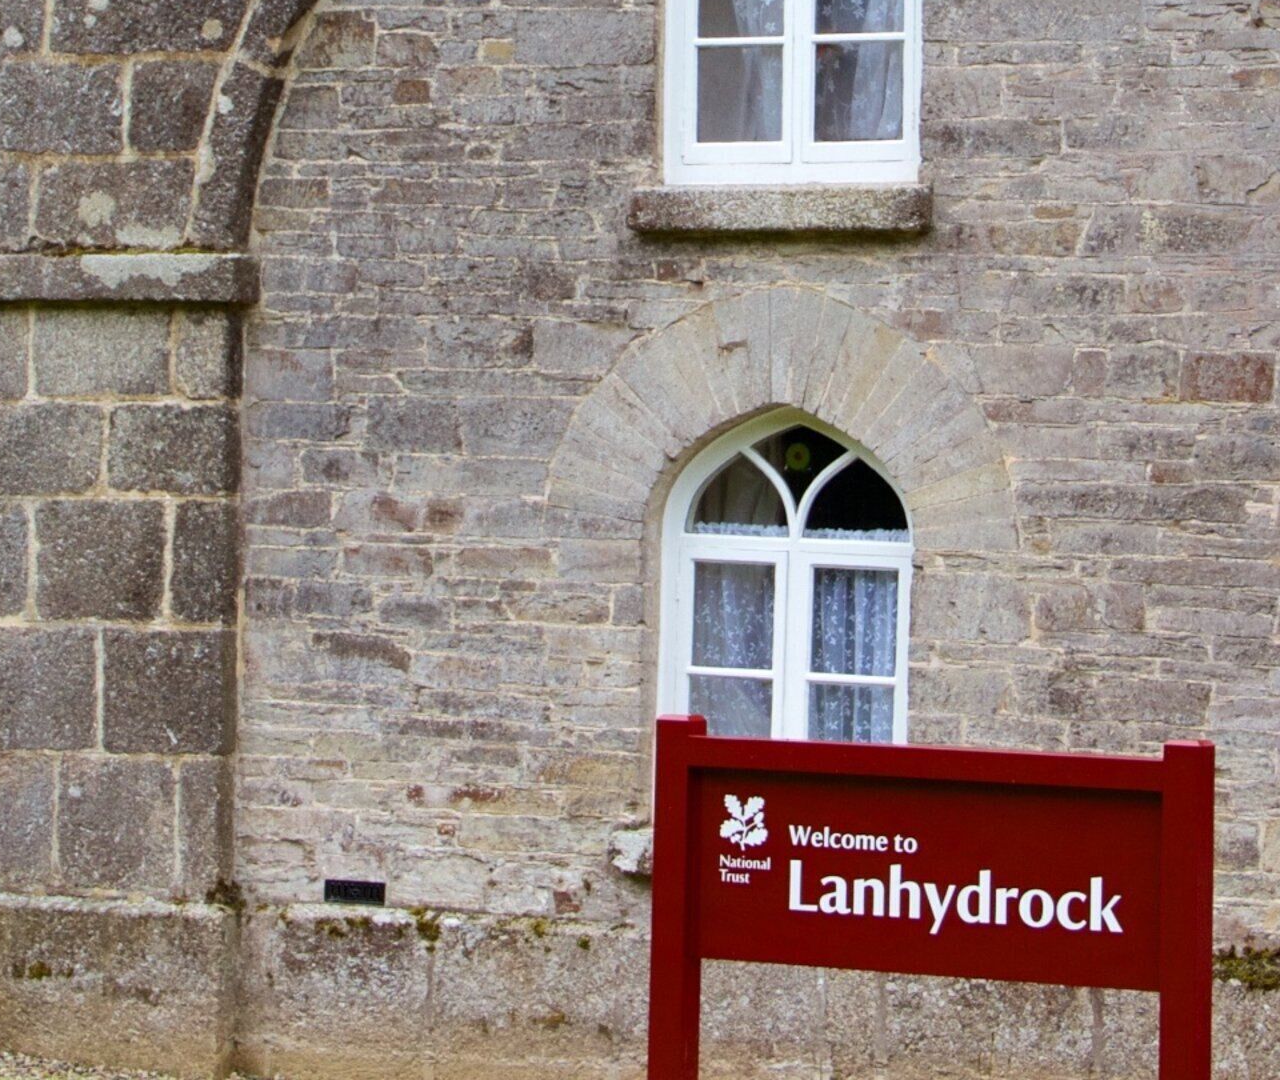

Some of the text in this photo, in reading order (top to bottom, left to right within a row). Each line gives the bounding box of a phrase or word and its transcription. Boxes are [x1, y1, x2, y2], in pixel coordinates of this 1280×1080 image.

[788, 825, 918, 854] Welcome to
[719, 854, 771, 870] National
[719, 868, 750, 884] Trust
[788, 859, 1123, 935] Lanhydrock
